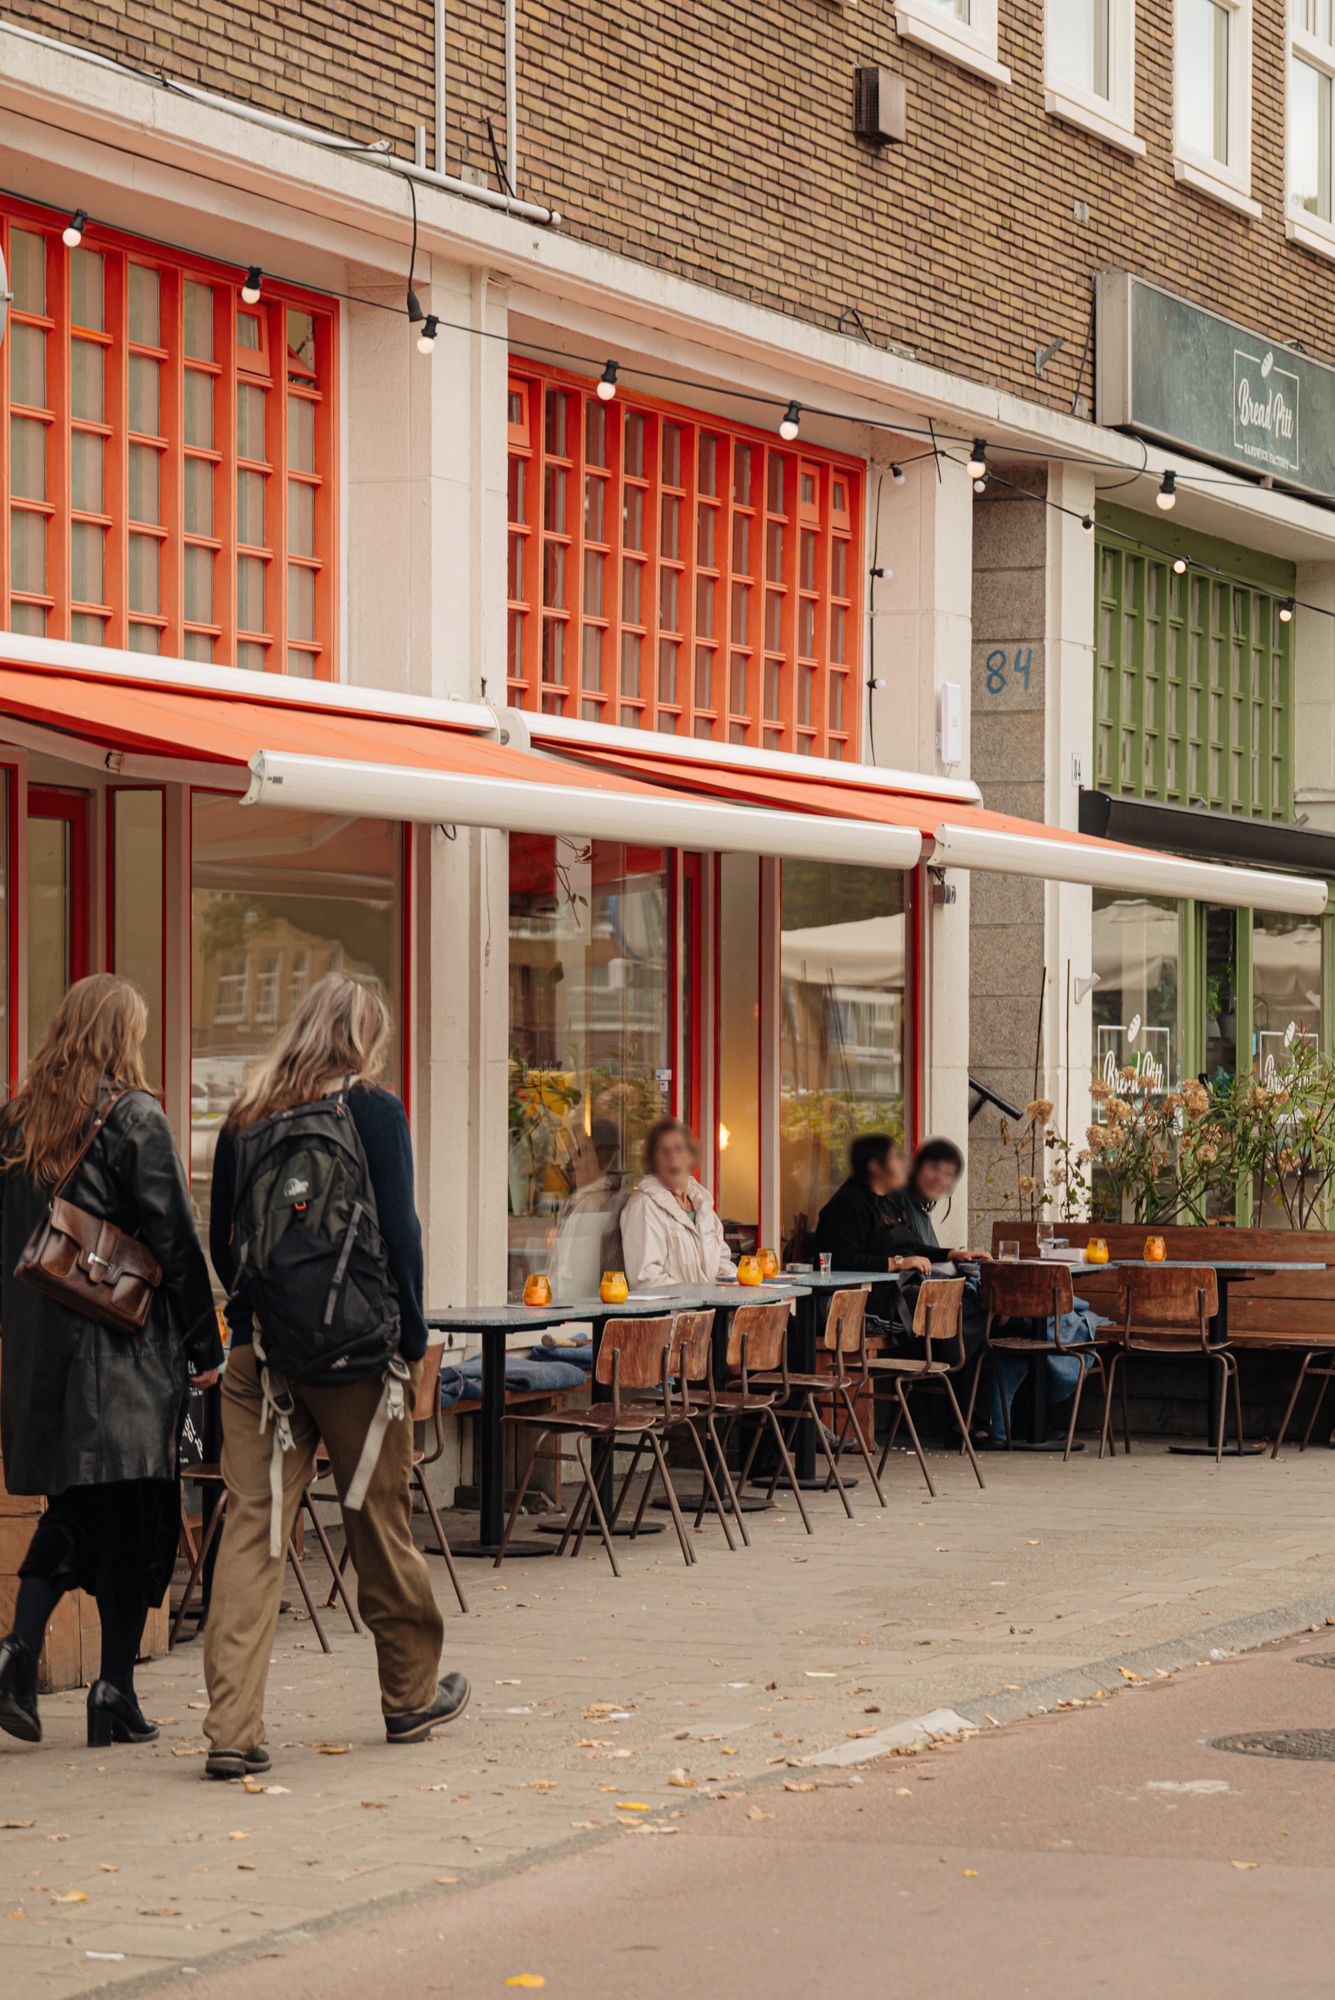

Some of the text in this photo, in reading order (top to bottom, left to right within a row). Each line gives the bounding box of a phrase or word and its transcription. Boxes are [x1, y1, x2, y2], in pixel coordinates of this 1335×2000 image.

[1238, 377, 1294, 439] Bread Pitt
[986, 648, 1033, 696] 84
